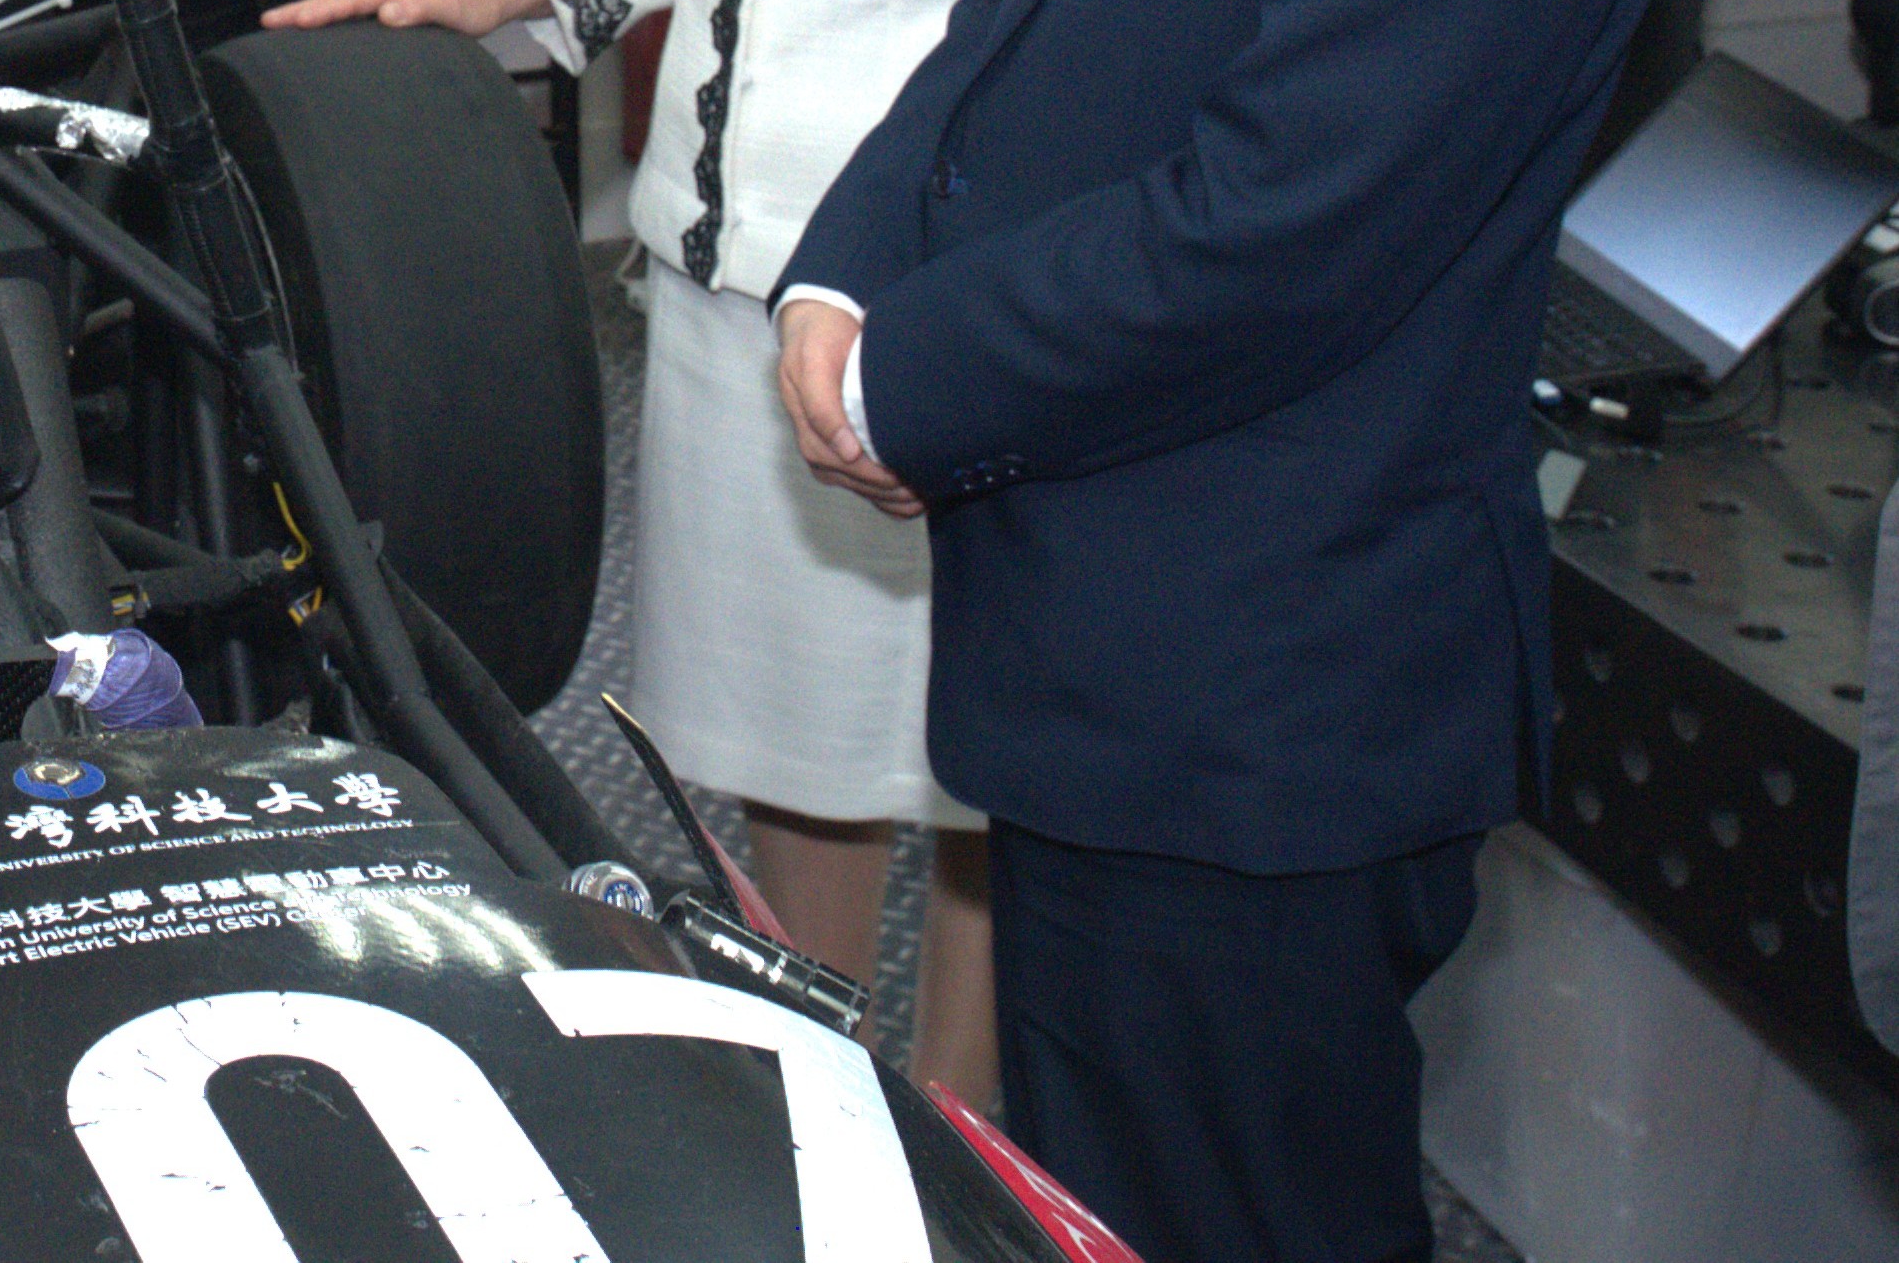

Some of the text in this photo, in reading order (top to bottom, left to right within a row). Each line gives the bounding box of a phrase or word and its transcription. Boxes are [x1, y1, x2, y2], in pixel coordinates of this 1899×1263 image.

[108, 843, 136, 856] OF
[140, 834, 227, 853] SCIENCE
[230, 830, 275, 843] AND
[279, 818, 414, 840] TECHNOLOGY
[18, 913, 146, 948] University
[152, 903, 179, 924] of
[182, 899, 277, 920] Science
[24, 933, 118, 961] Electric
[120, 921, 212, 946] Vehicle
[216, 911, 282, 935] (SEV)
